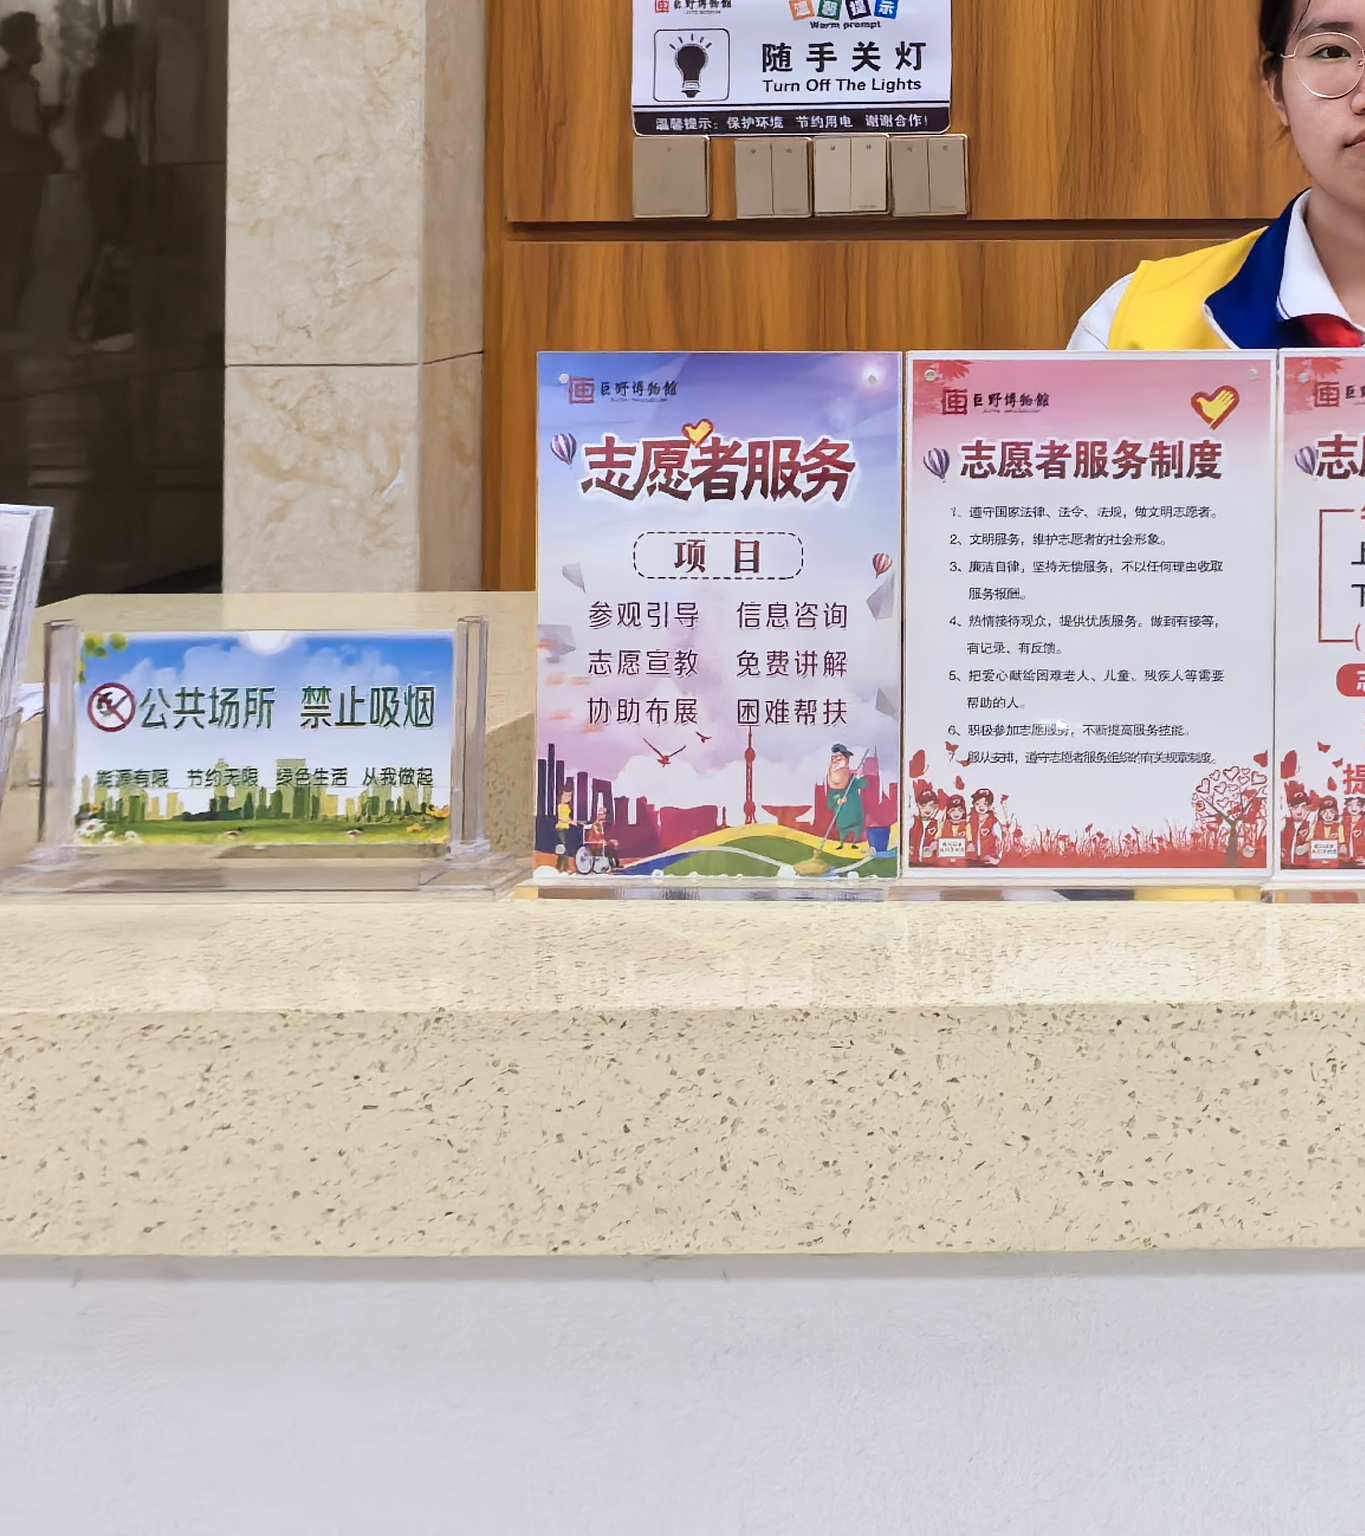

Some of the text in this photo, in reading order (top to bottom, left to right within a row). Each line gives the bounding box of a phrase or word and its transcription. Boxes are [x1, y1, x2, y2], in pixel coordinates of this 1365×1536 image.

[810, 20, 881, 30] Warm prompt
[761, 41, 927, 73] 随手关灯
[762, 77, 922, 94] Turn Off The Lights
[796, 115, 853, 129] 节约用电
[580, 435, 857, 503] 志愿者服务
[959, 439, 1224, 481] 志愿者服务制度
[672, 539, 762, 574] 项目
[587, 600, 849, 630] 参观引导 信息咨询
[587, 648, 849, 677] 志愿宣教 免费讲解
[138, 685, 435, 731] 公共场所 禁止吸烟
[587, 696, 849, 726] 协助布展 困难帮扶
[187, 767, 259, 788] 节约无限
[276, 766, 348, 788] 绿色生活
[363, 766, 434, 788] 从我做起
